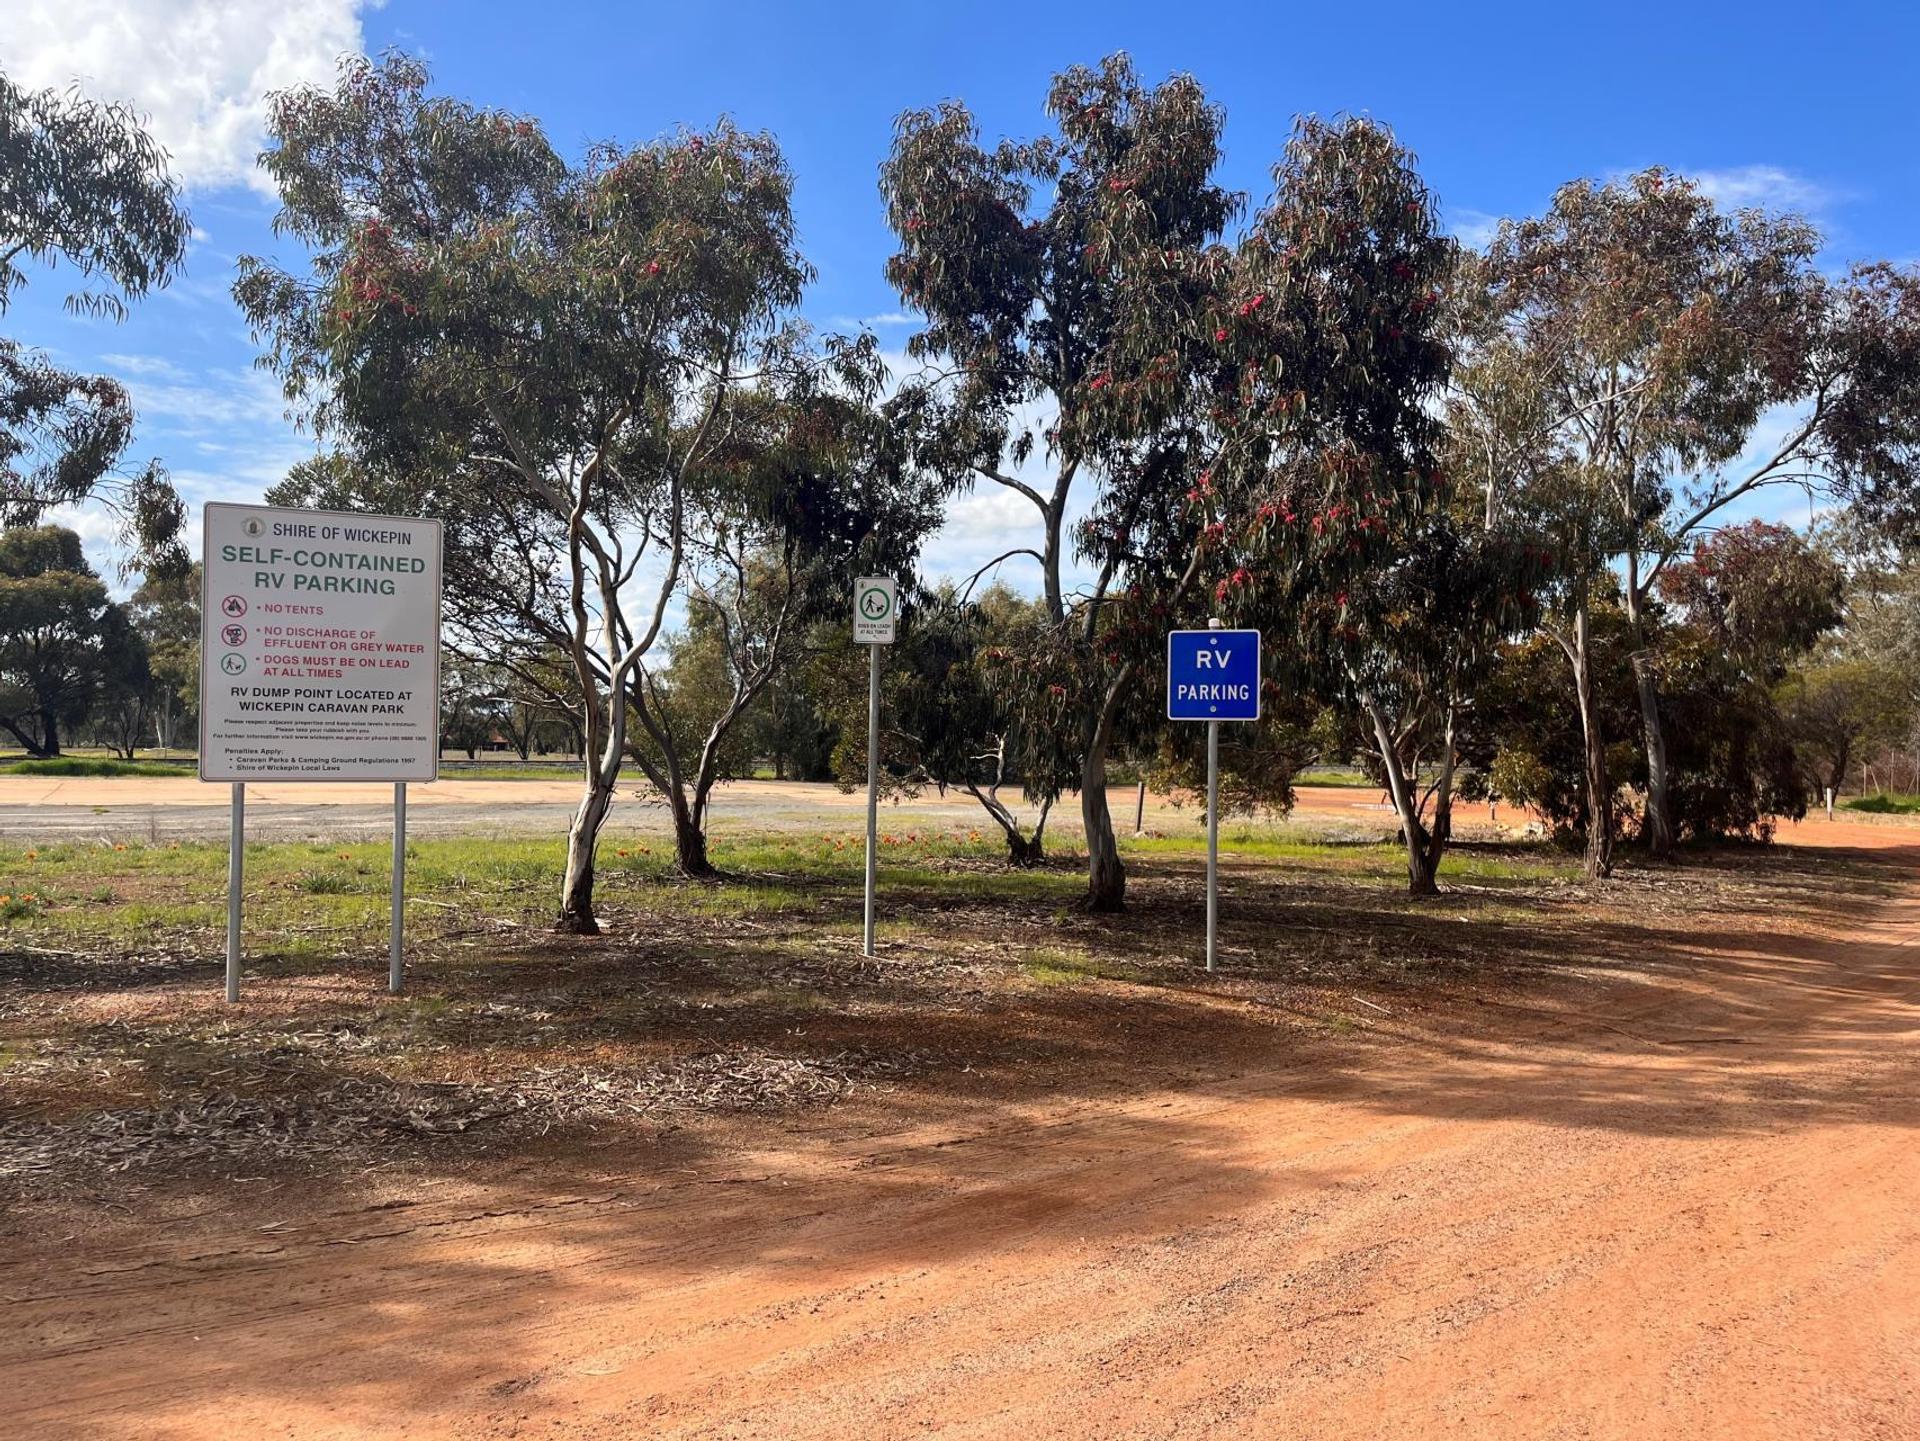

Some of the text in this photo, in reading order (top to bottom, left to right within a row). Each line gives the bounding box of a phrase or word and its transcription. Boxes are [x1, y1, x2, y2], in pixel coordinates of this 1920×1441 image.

[273, 523, 411, 545] SHIRE OF WICKEPIN
[222, 545, 426, 574] SELF-CONTAINED
[255, 571, 395, 595] RV PARKING
[264, 604, 324, 615] NO TENTS
[264, 626, 376, 640] NO DISCHARGE OF
[264, 639, 425, 654] EFFLUENT OR GREY WATER
[264, 655, 410, 669] DOGS MUST BE ON LEAD
[1196, 650, 1232, 669] RV
[263, 667, 343, 678] AT ALL TIMES
[230, 687, 412, 701] RV DUMP POINT LOCATED AT
[1178, 684, 1250, 701] PARKING
[239, 701, 404, 714] WICKEPIN CARAVAN PARK
